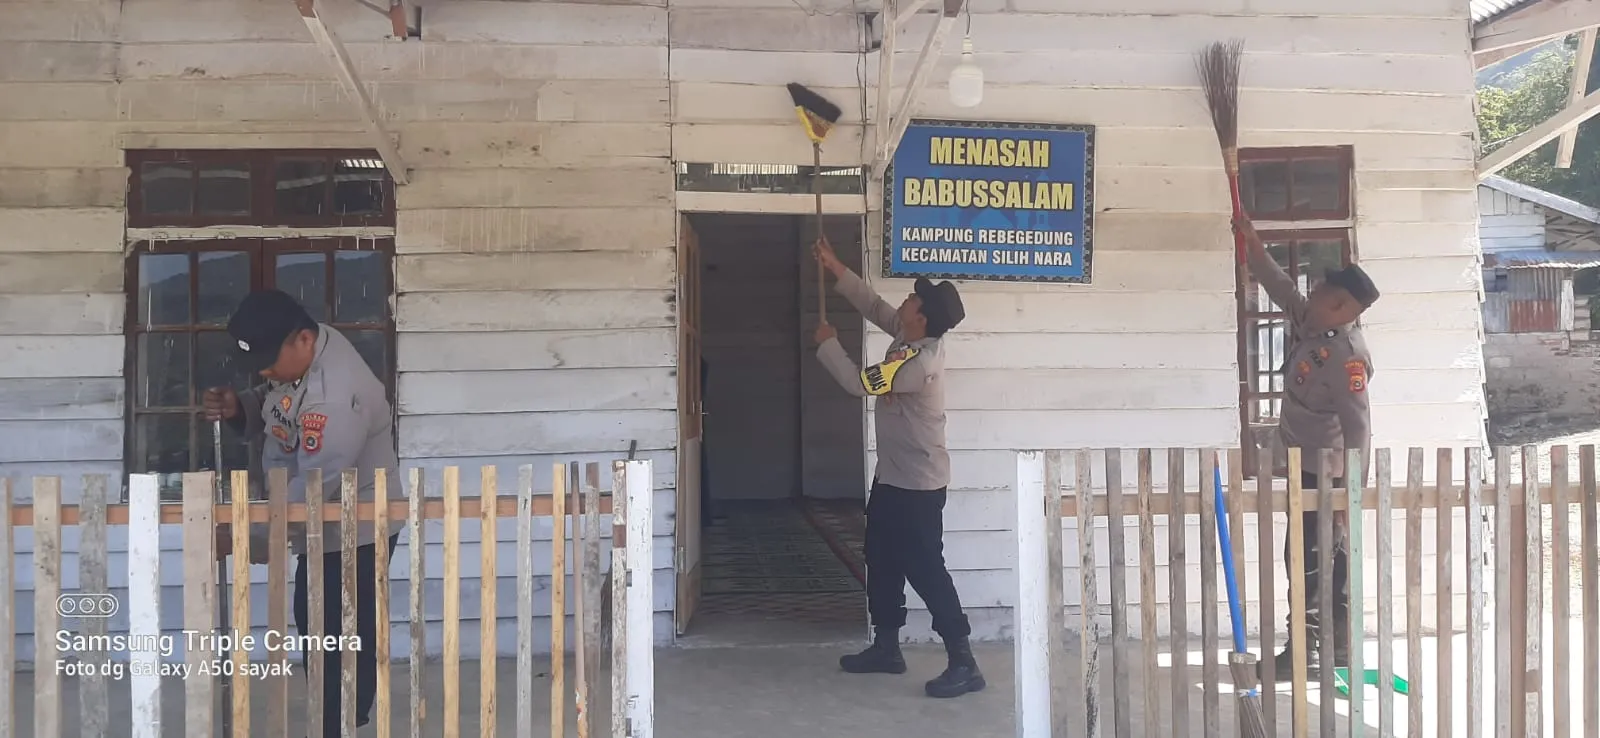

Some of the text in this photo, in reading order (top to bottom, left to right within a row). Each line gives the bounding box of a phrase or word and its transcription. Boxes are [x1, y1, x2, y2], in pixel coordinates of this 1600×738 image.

[930, 136, 1049, 168] MENASAH
[904, 177, 1073, 210] BABUSSALAM
[902, 226, 1073, 246] KAMPUNG REBEGEDUNG
[901, 247, 1073, 266] KECAMATAN SILIH NARA
